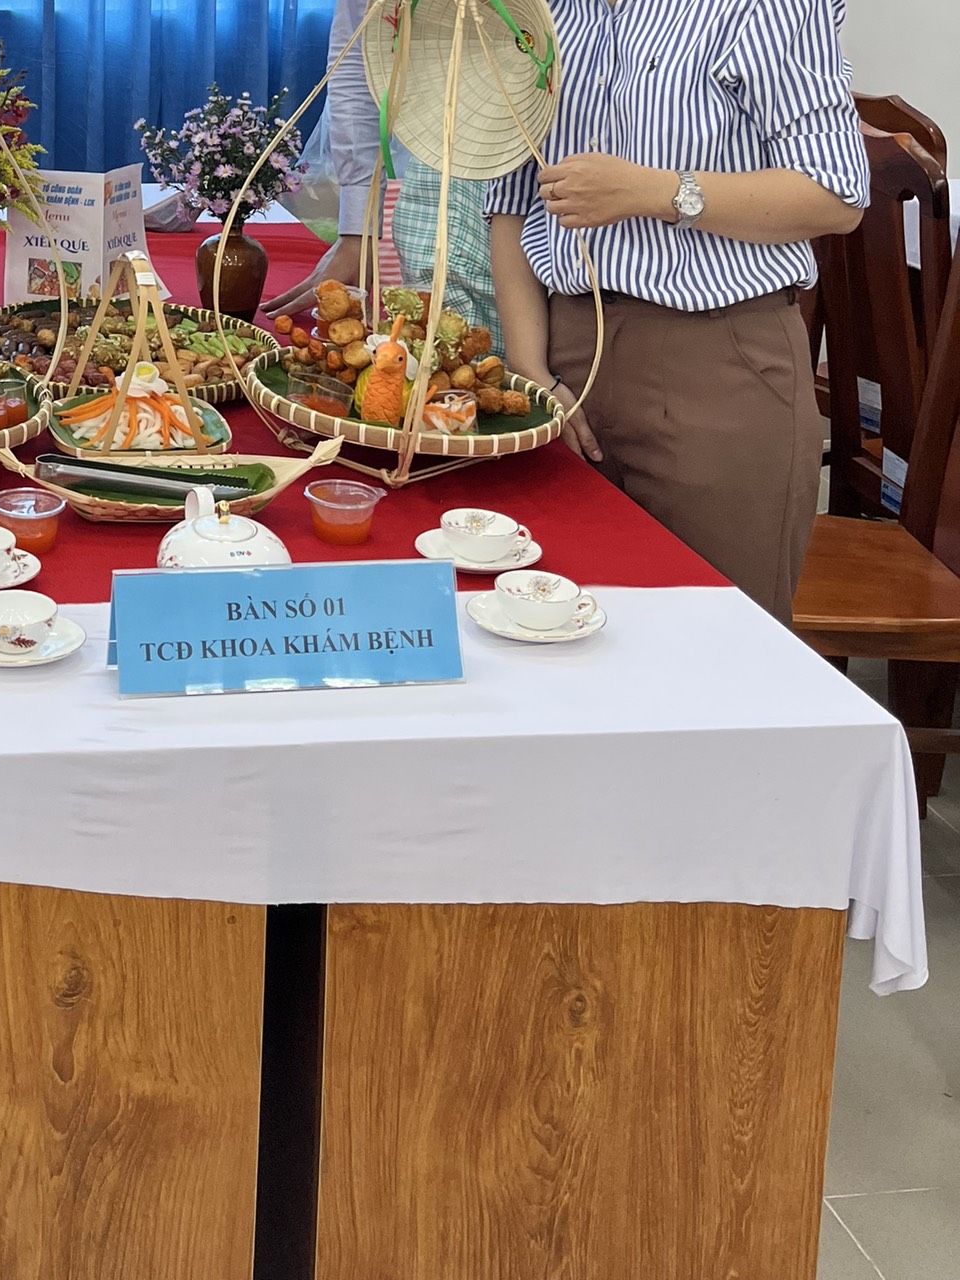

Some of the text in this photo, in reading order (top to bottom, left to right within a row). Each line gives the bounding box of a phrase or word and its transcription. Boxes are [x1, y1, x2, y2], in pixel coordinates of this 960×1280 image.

[51, 183, 66, 194] CÔNG
[83, 198, 96, 207] LCK
[23, 234, 90, 254] XIÊN QUE
[123, 232, 137, 247] QUE
[226, 592, 346, 621] BÀN SỐ 01
[140, 627, 435, 663] TCĐ KHOA KHÁM BỆNH
